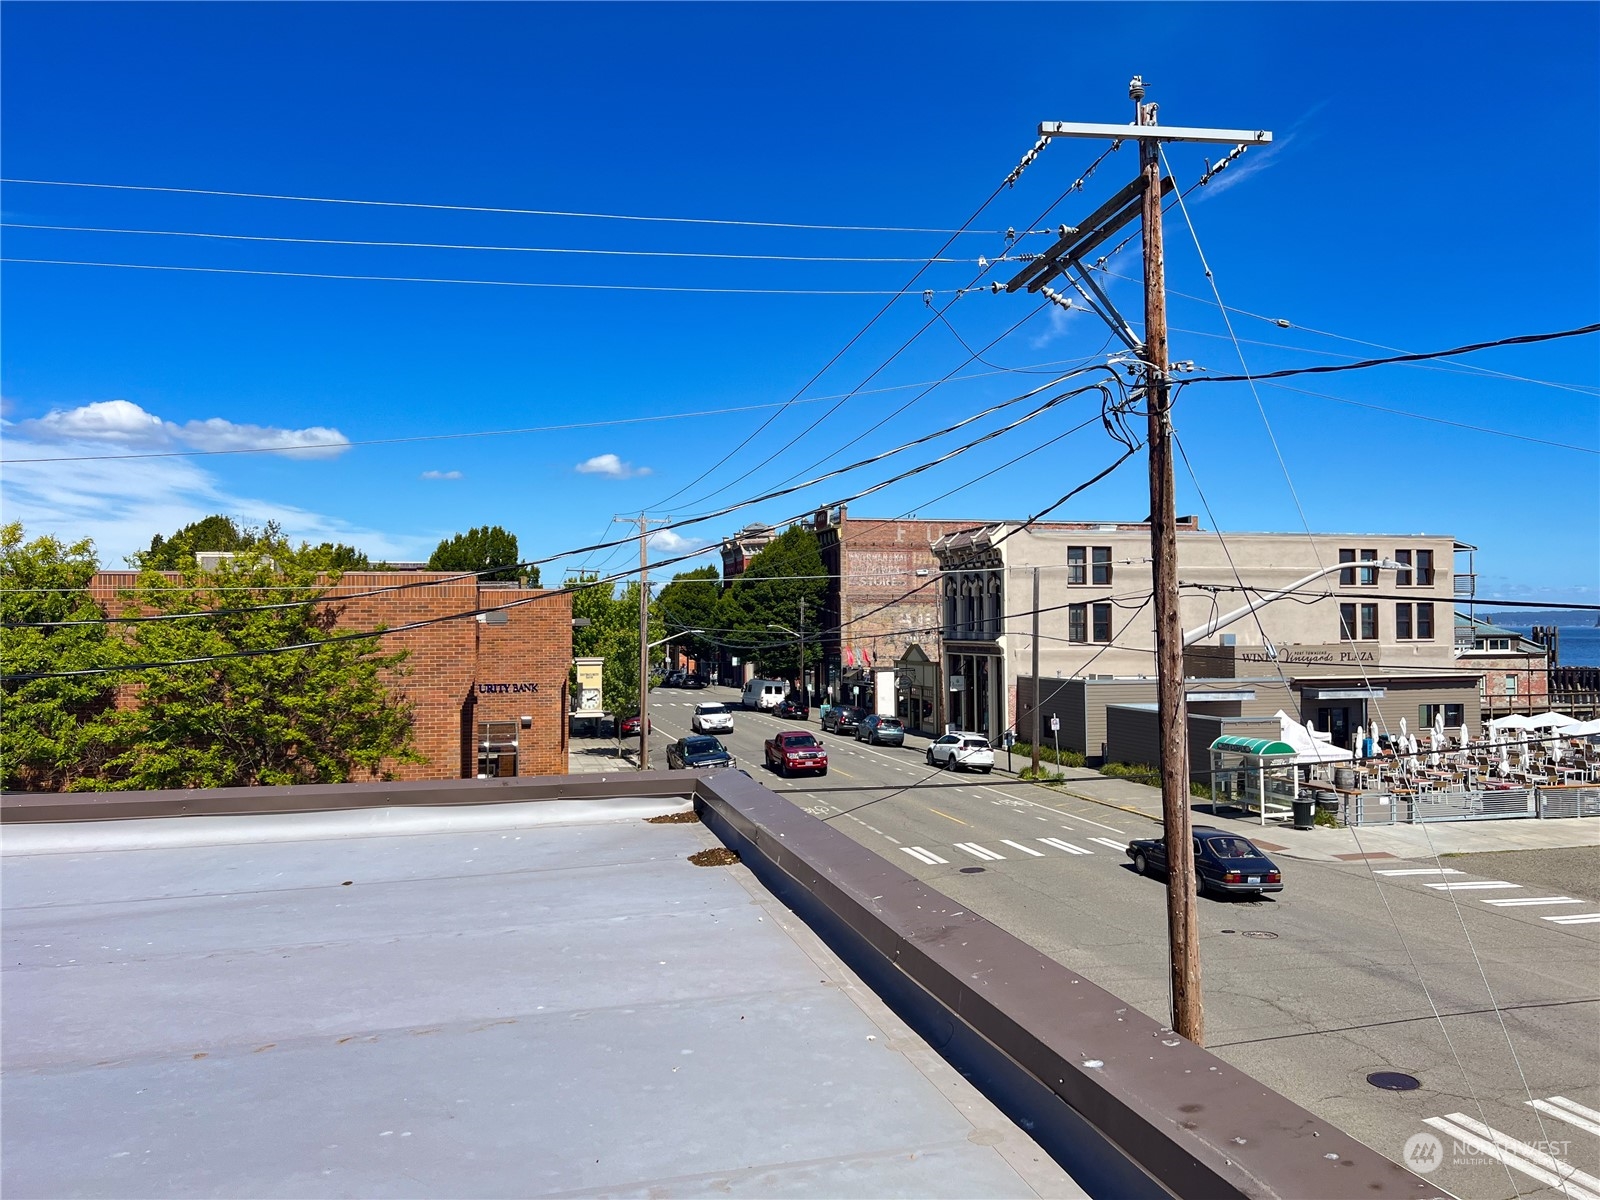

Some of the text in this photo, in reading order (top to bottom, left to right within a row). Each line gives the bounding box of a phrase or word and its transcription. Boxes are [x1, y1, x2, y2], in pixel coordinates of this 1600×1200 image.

[1279, 648, 1334, 667] Vineyards
[1340, 652, 1374, 662] PLAZA
[478, 683, 539, 694] URITY BANK
